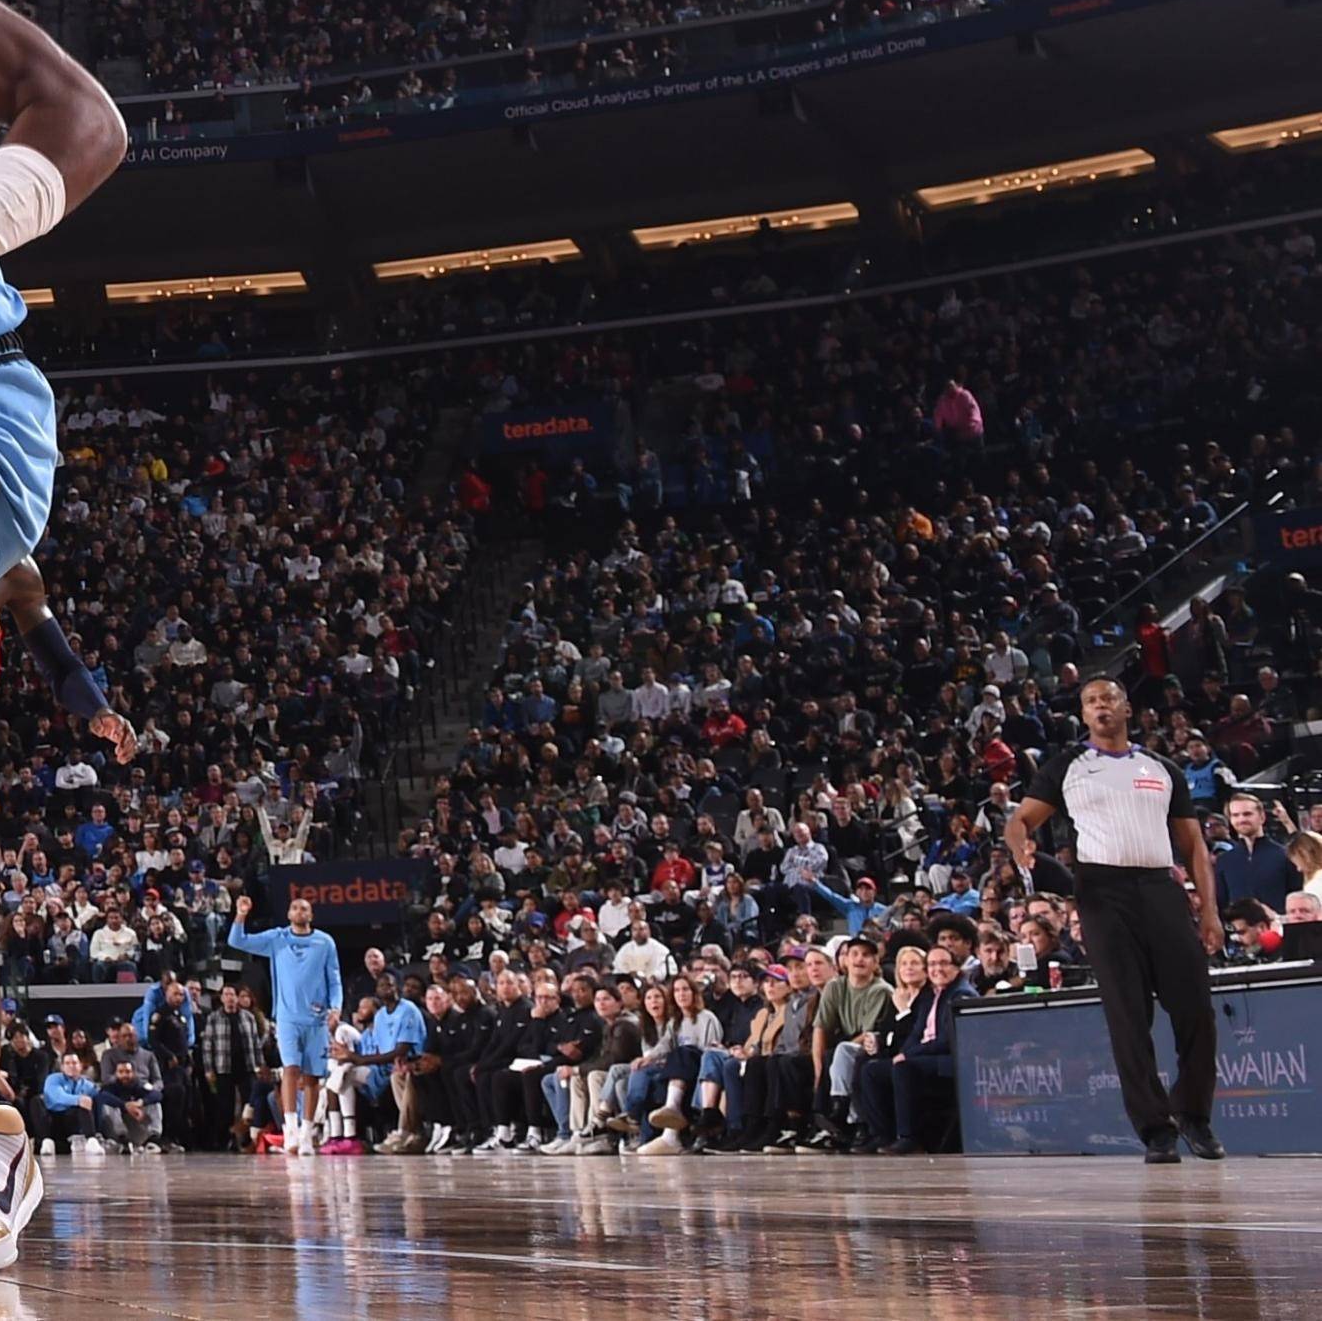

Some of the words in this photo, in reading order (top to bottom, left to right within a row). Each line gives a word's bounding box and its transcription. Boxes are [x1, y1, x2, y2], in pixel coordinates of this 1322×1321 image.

[504, 101, 549, 119] Official
[551, 97, 589, 113] Cloud
[592, 88, 650, 105] Analytics
[654, 81, 700, 97] Partner
[722, 74, 745, 87] the
[748, 69, 766, 83] LA
[768, 60, 821, 80] Clippers
[824, 54, 848, 67] and
[887, 36, 927, 54] Dome
[141, 147, 156, 162] AI
[159, 145, 228, 162] Company
[1215, 1043, 1307, 1087] AWAIIAN
[1222, 1102, 1288, 1118] ISLANDS
